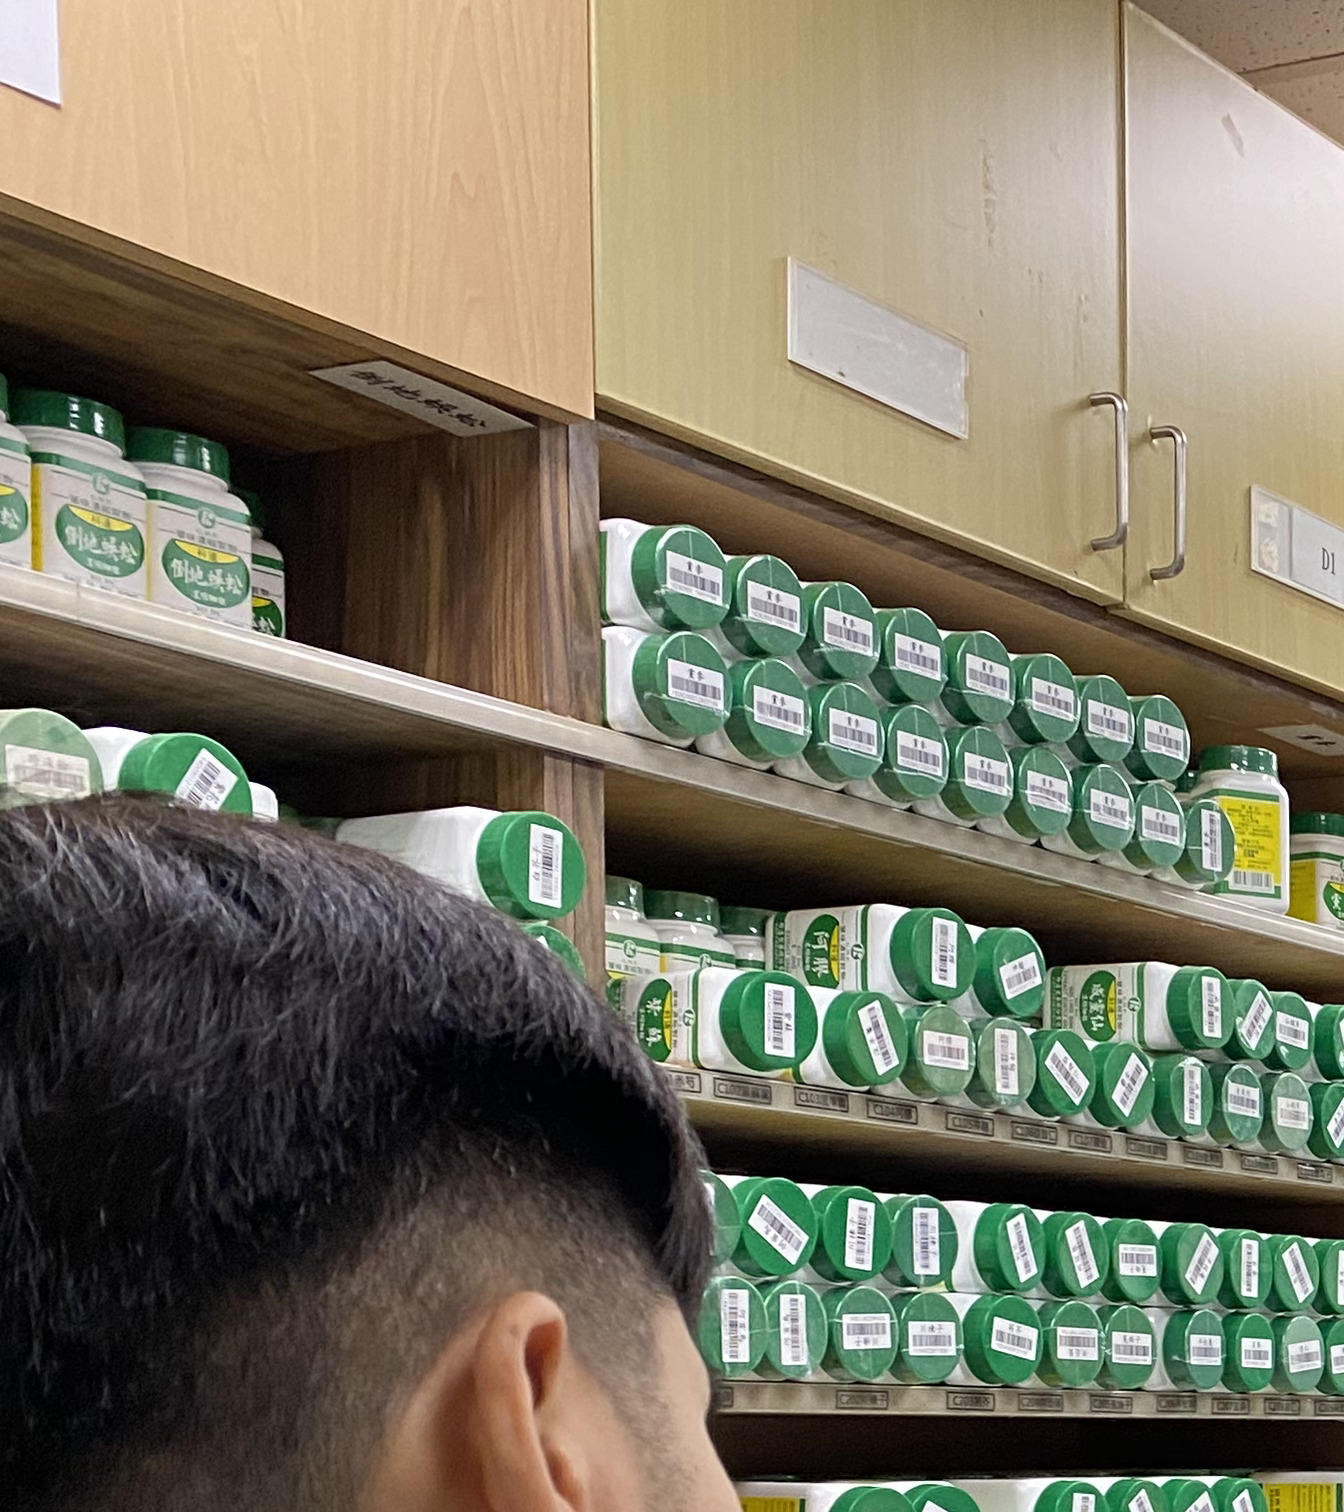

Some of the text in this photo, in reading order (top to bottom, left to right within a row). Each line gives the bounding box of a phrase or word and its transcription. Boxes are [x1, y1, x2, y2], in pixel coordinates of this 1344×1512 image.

[1322, 548, 1335, 575] D1
[1087, 983, 1107, 1032] 威靈仙
